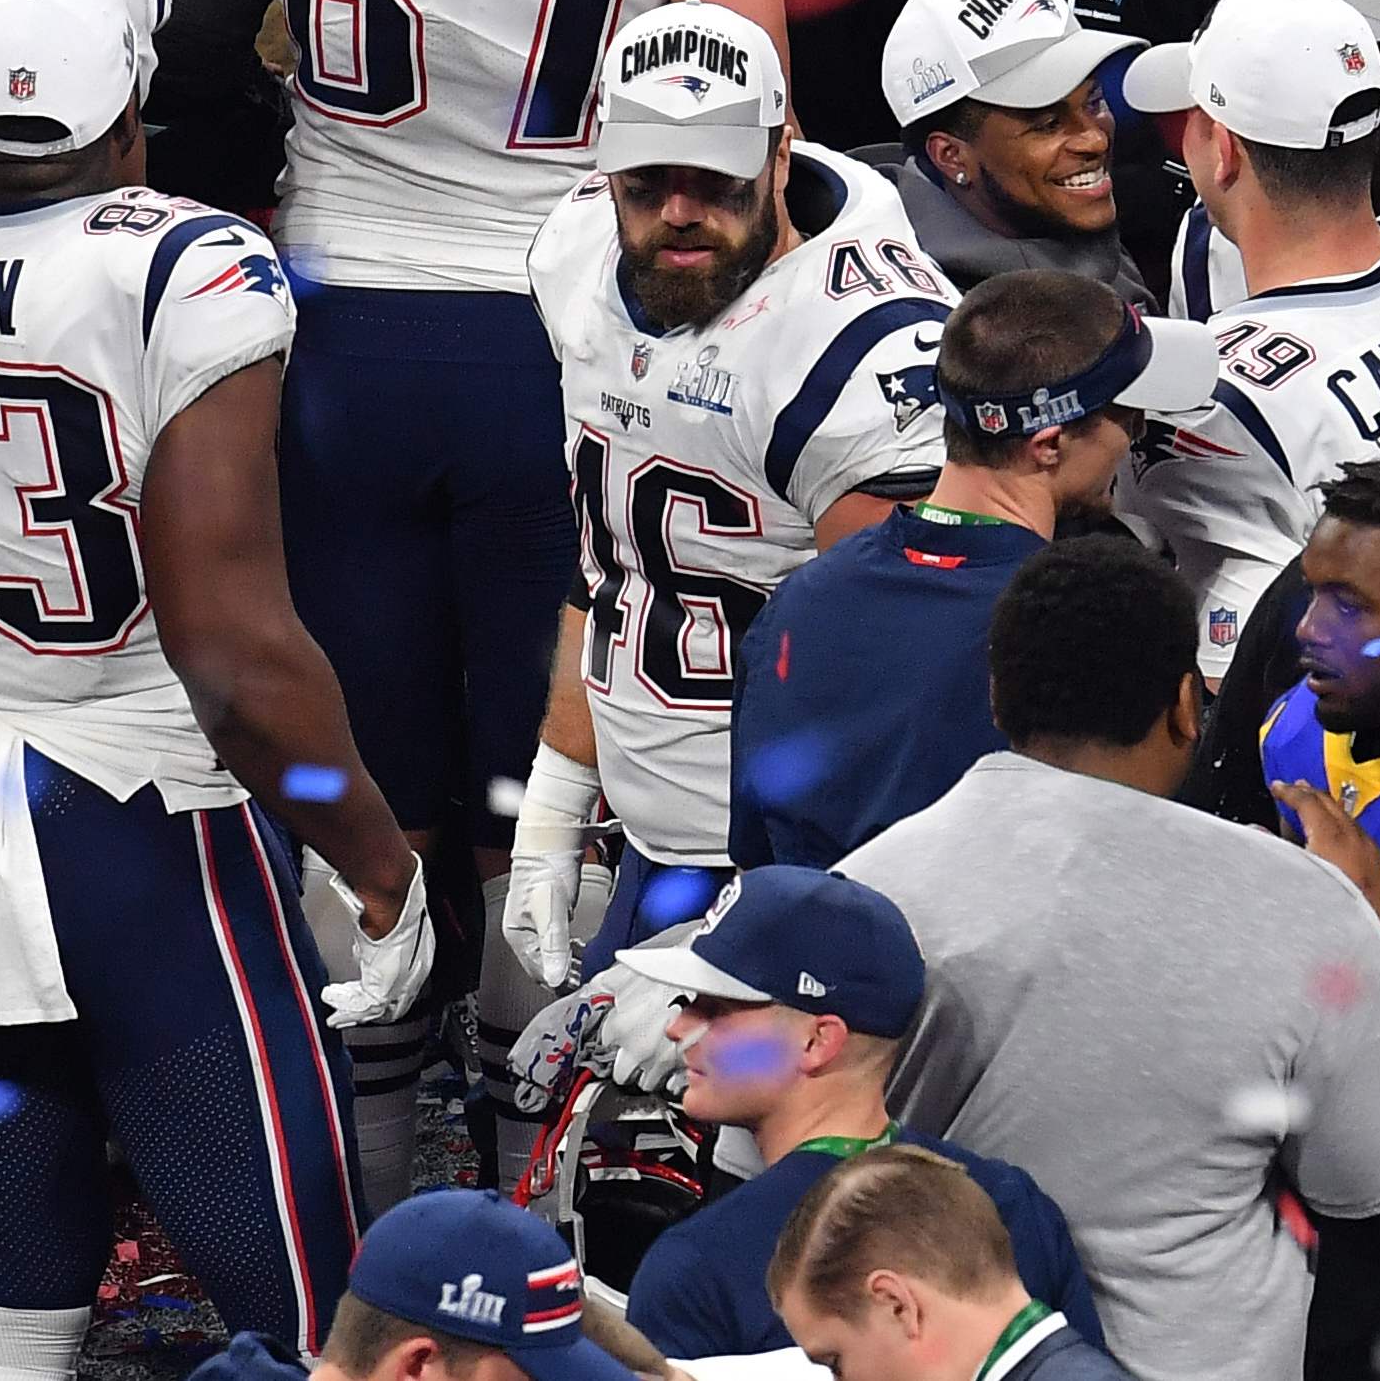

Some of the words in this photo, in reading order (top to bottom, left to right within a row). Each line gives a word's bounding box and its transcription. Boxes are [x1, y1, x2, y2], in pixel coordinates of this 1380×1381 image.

[620, 30, 749, 87] CHAMPIONS
[824, 239, 950, 301] 46
[568, 423, 765, 711] 46
